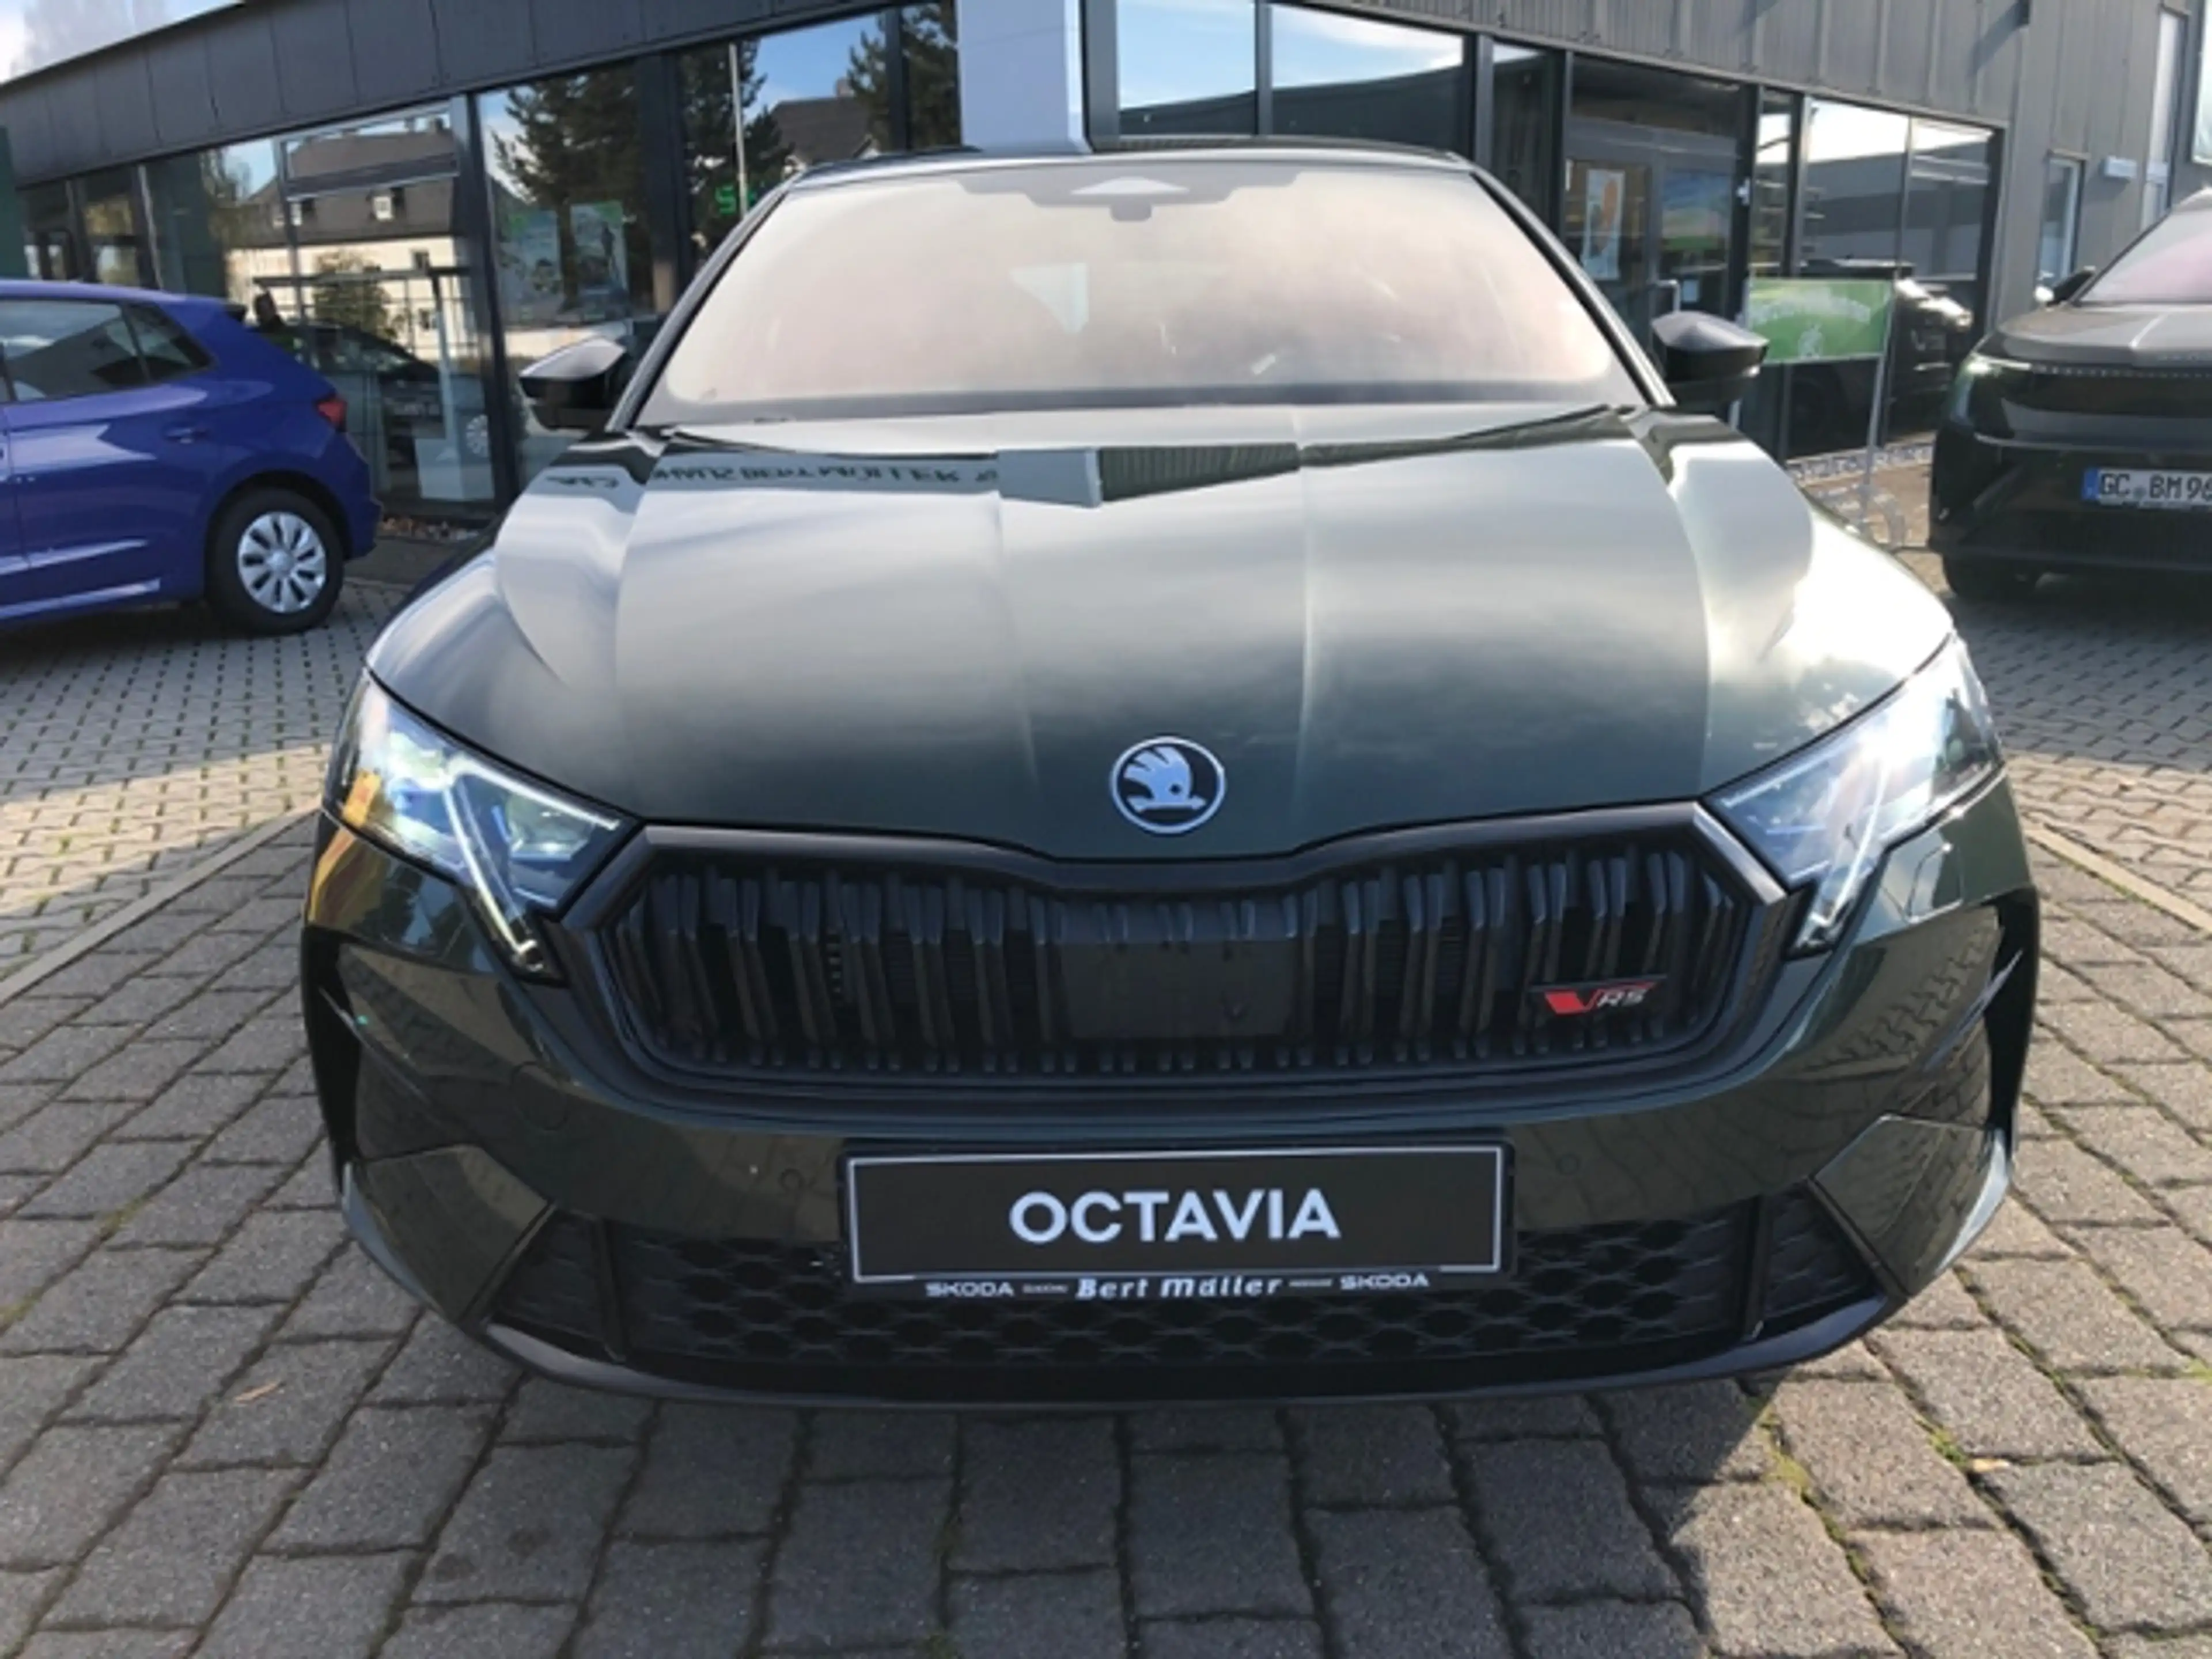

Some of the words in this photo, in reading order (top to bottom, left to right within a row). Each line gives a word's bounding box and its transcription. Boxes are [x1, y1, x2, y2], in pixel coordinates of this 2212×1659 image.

[2102, 473, 2130, 495] GC
[2150, 474, 2182, 499] BM
[1009, 1187, 1341, 1245] OCTAVIA
[925, 1281, 1015, 1298] SKODA
[1075, 1277, 1148, 1300] Bert
[1339, 1272, 1430, 1291] SKODA
